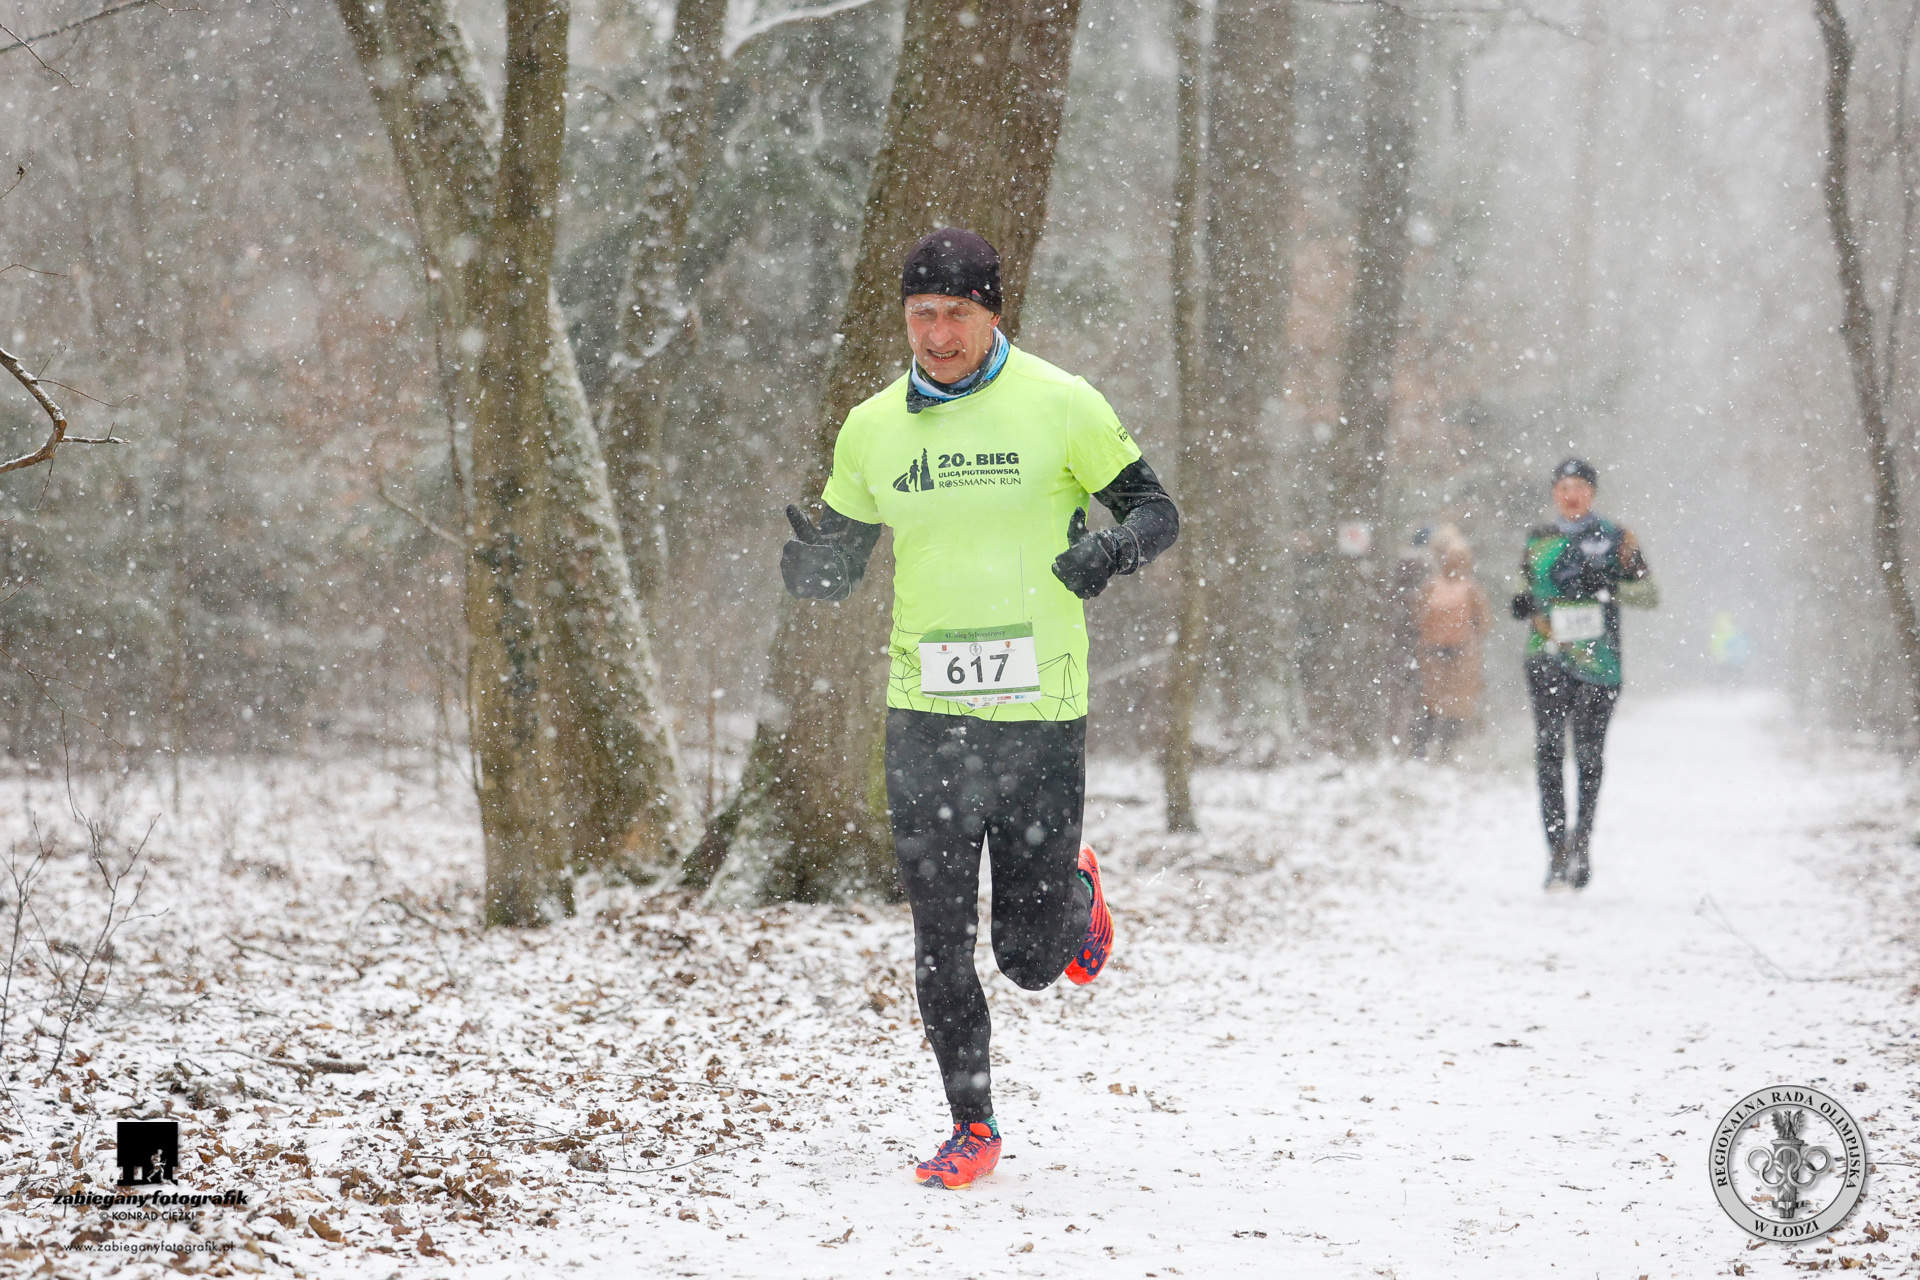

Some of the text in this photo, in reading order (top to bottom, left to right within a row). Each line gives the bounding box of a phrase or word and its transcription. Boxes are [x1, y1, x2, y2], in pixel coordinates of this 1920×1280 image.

[938, 452, 1020, 469] 20. BIEG
[938, 468, 1020, 478] ULICĄ PIOTRKOWSKĄ
[938, 477, 1022, 489] ROSSMANN RUN
[946, 653, 1009, 685] 617
